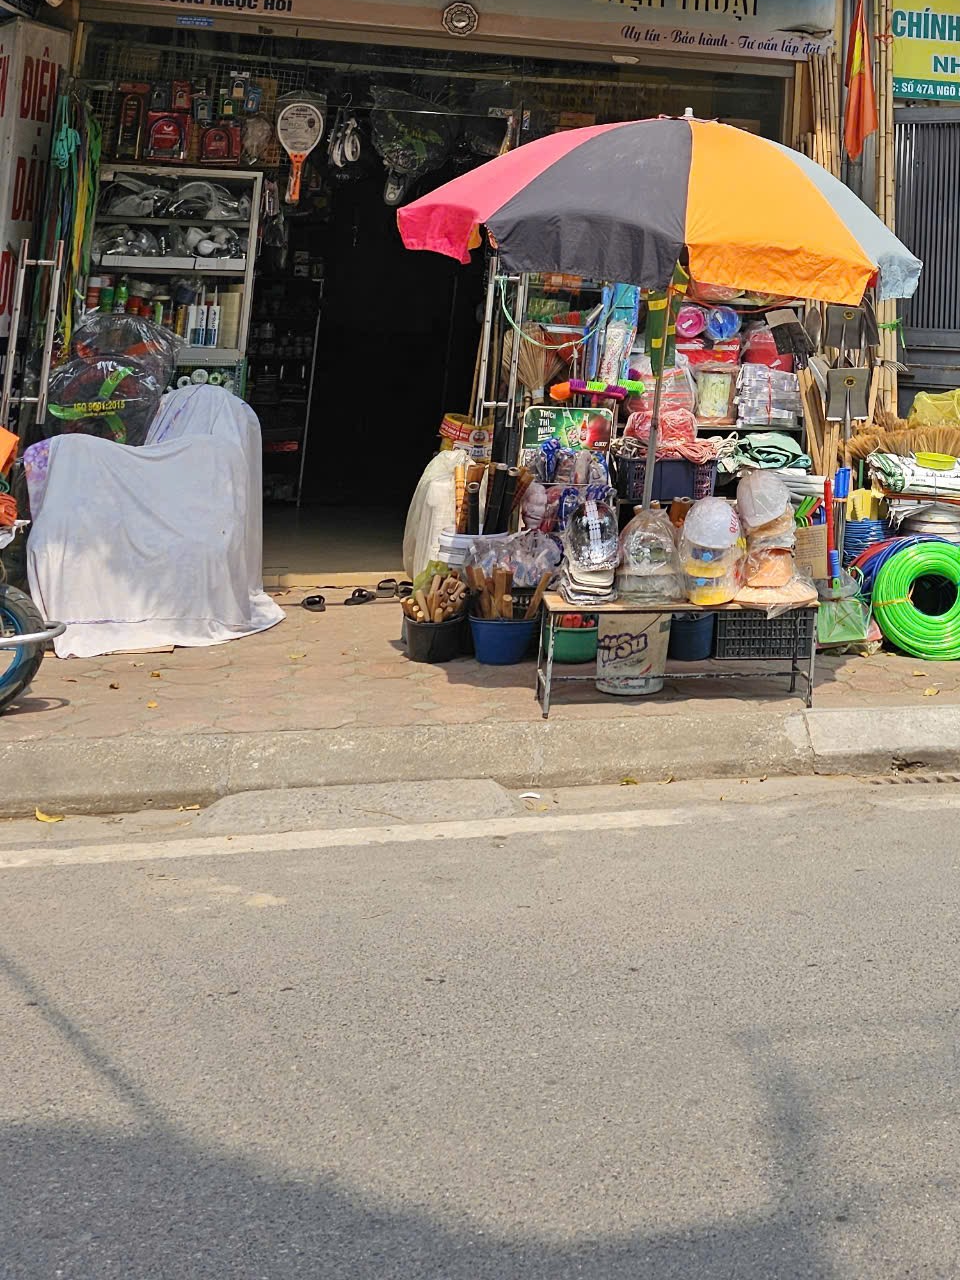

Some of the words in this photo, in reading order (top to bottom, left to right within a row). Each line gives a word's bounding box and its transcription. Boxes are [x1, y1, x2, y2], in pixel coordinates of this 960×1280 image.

[620, 24, 641, 43] Uy
[644, 27, 661, 42] tín
[671, 28, 695, 45] Bảo
[698, 31, 728, 48] hành
[738, 34, 757, 50] Tư
[757, 37, 778, 52] vấn
[781, 38, 799, 56] lắp
[901, 80, 914, 93] SỐ
[916, 84, 934, 95] 47A
[937, 84, 956, 96] NGÕ
